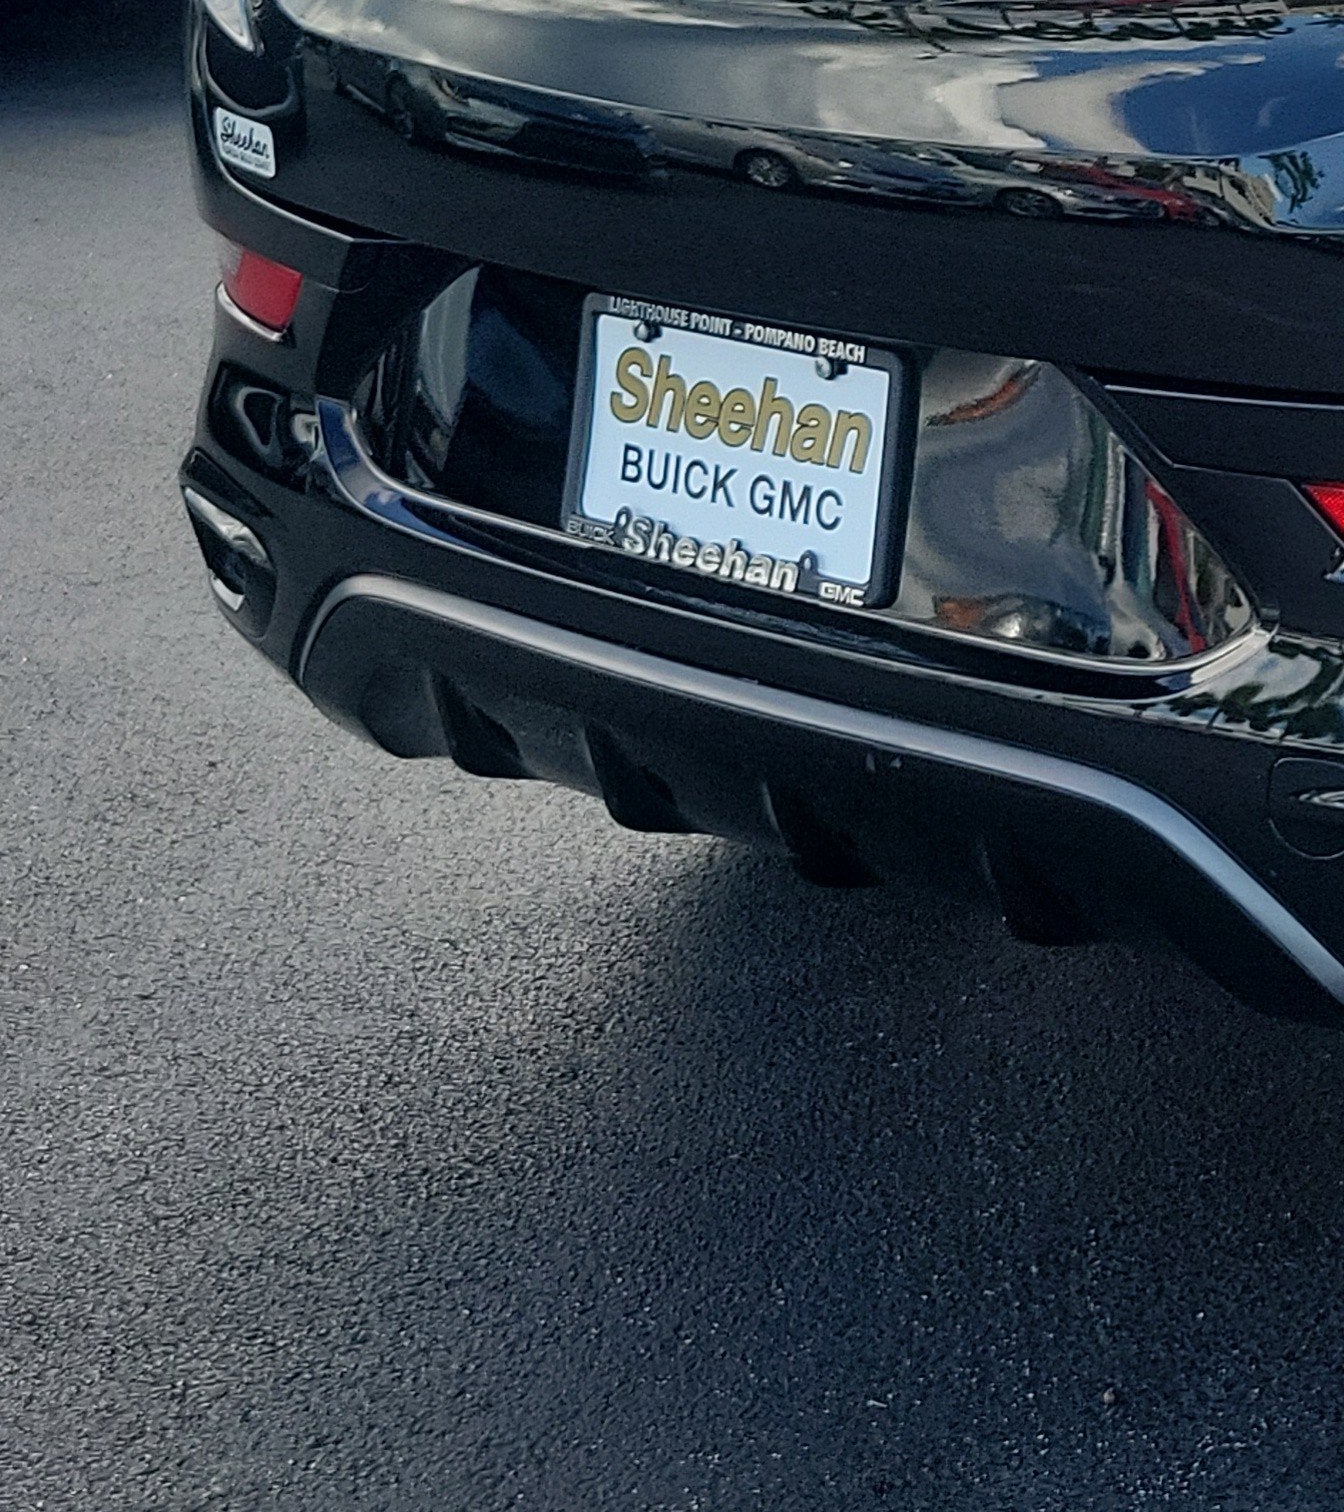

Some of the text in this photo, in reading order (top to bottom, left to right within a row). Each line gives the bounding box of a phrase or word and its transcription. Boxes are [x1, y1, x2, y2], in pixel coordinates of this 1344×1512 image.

[610, 296, 689, 326] LIGHTHOUSE
[690, 312, 733, 336] POINT
[744, 322, 816, 353] POMPANO
[817, 338, 866, 364] BEACH
[610, 346, 874, 475] Sheehan
[620, 442, 844, 531] BUICK GMC
[566, 515, 866, 608] BUICK Sheehan GMC
